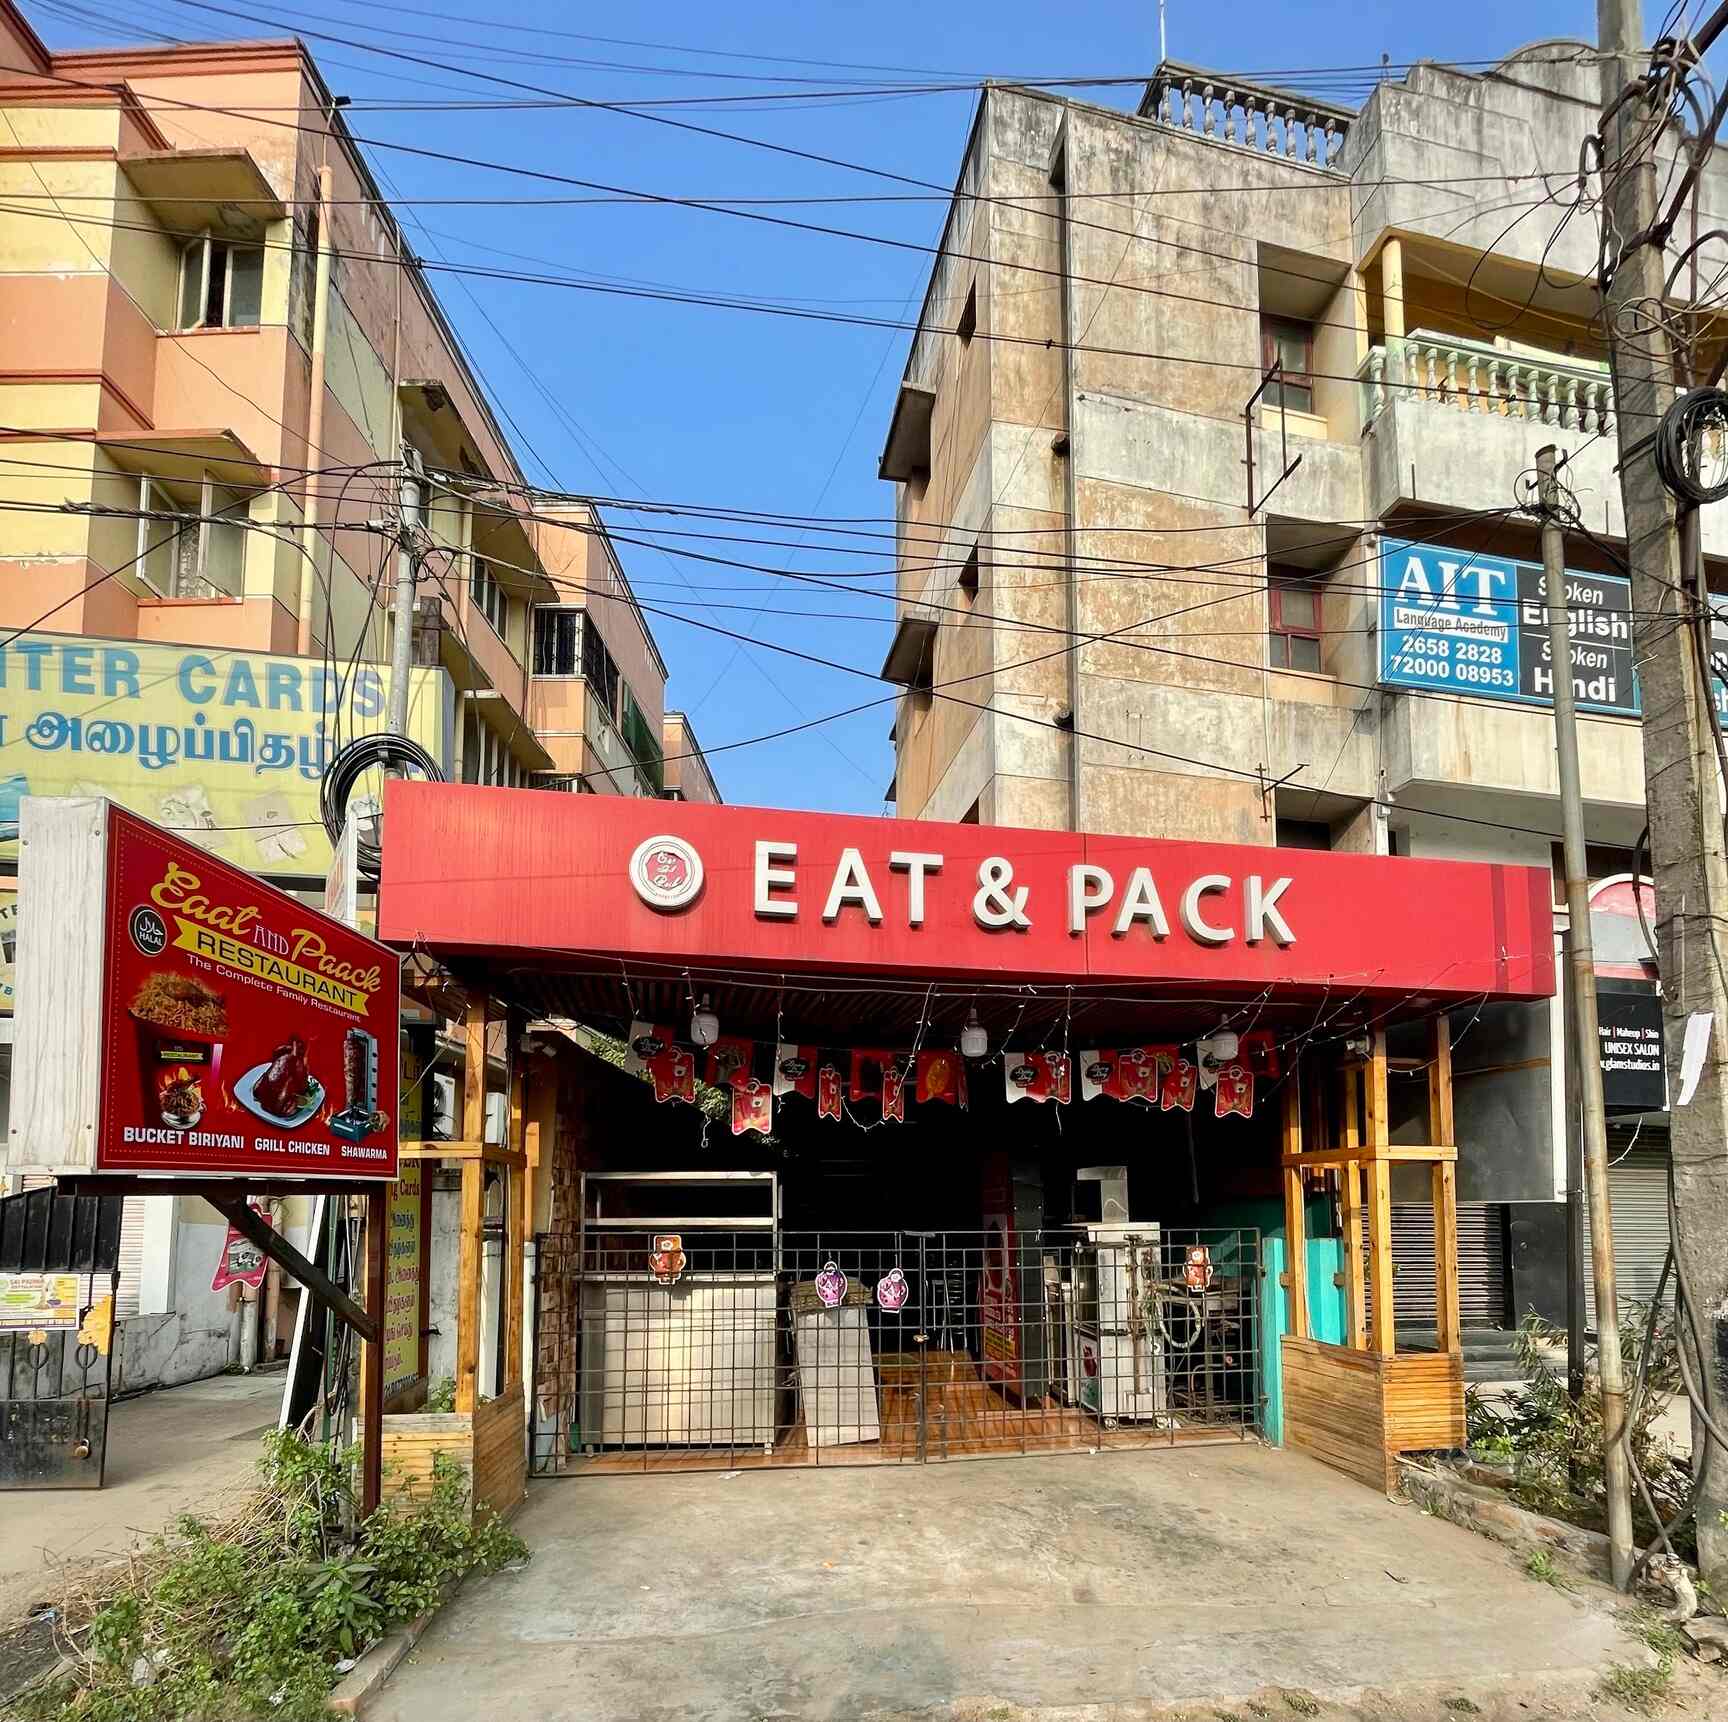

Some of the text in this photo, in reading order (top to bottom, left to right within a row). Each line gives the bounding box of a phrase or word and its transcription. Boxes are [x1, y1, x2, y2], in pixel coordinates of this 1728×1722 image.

[1395, 556, 1506, 616] AIT
[1538, 575, 1604, 606] Soken
[1396, 609, 1507, 641] Language Academy
[1402, 635, 1502, 665] 2658 2828
[1541, 640, 1608, 669] Soken
[178, 654, 386, 718] CARDS
[1455, 663, 1514, 687] 08953
[1534, 666, 1617, 703] Hndi
[755, 840, 944, 926] EAT
[973, 857, 1033, 929] &
[1067, 864, 1297, 946] PACK
[139, 931, 163, 946] HALAL
[151, 861, 381, 992] Eaat AND Paack
[197, 930, 357, 1007] RESTAURANT
[187, 953, 361, 1023] The Complete Family Restaurant
[1604, 1041, 1660, 1057] UNISEX SALON
[124, 1127, 244, 1149] BUCKET BIRIYANI
[255, 1137, 330, 1156] GRILL CHICKEN
[341, 1145, 388, 1160] SHAWARMA
